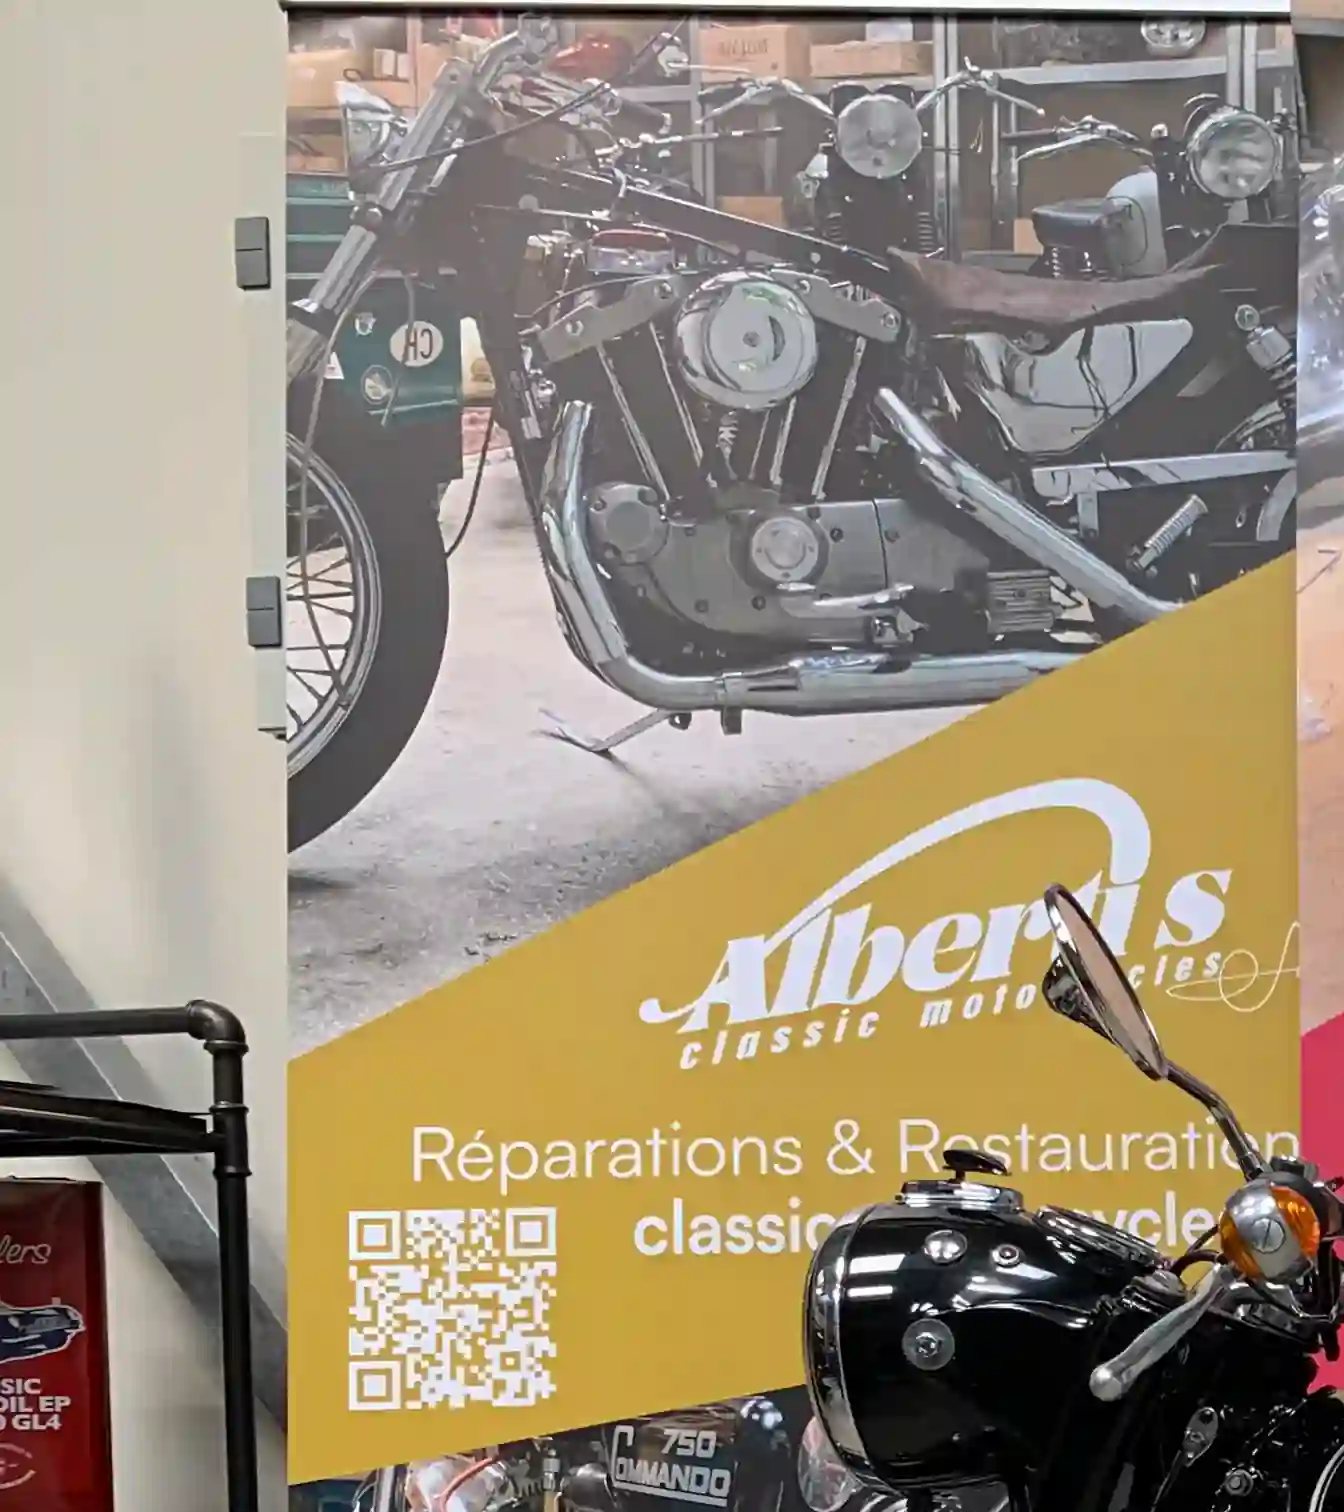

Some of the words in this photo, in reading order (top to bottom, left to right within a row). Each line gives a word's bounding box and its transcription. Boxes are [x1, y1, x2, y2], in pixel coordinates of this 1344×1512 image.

[680, 1011, 880, 1070] classic
[919, 951, 1222, 1028] motocles
[413, 1120, 803, 1195] Réparations
[826, 1119, 875, 1175] &
[11, 1413, 62, 1431] GL4
[39, 1395, 72, 1413] EP
[611, 1415, 732, 1498] COMMANDO
[661, 1428, 717, 1459] 750
